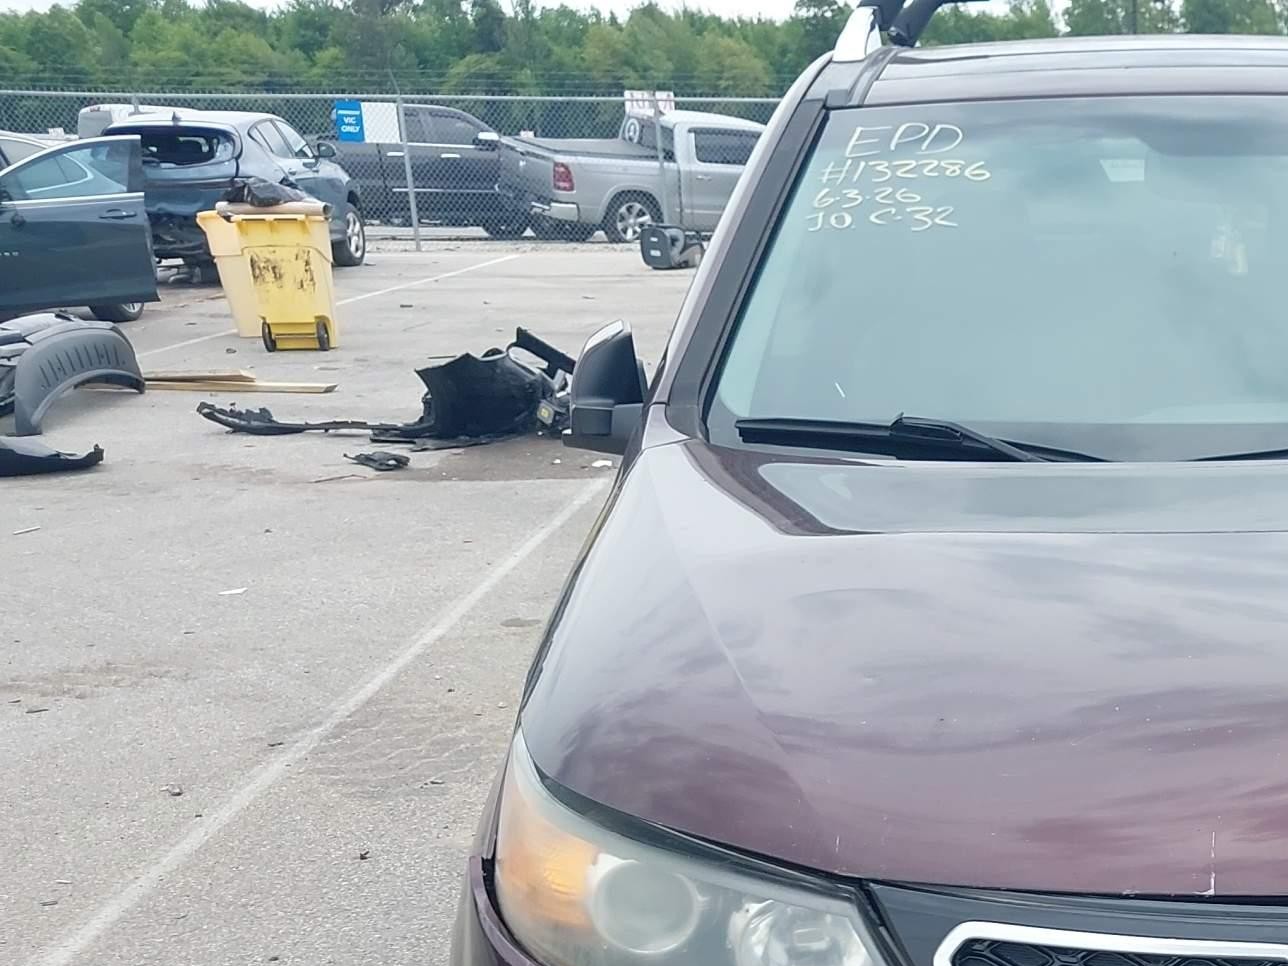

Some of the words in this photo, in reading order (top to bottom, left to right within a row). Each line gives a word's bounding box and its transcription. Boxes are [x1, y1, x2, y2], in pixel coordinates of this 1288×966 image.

[343, 116, 357, 124] VIC
[340, 125, 361, 133] ONLY
[845, 122, 963, 157] EPD
